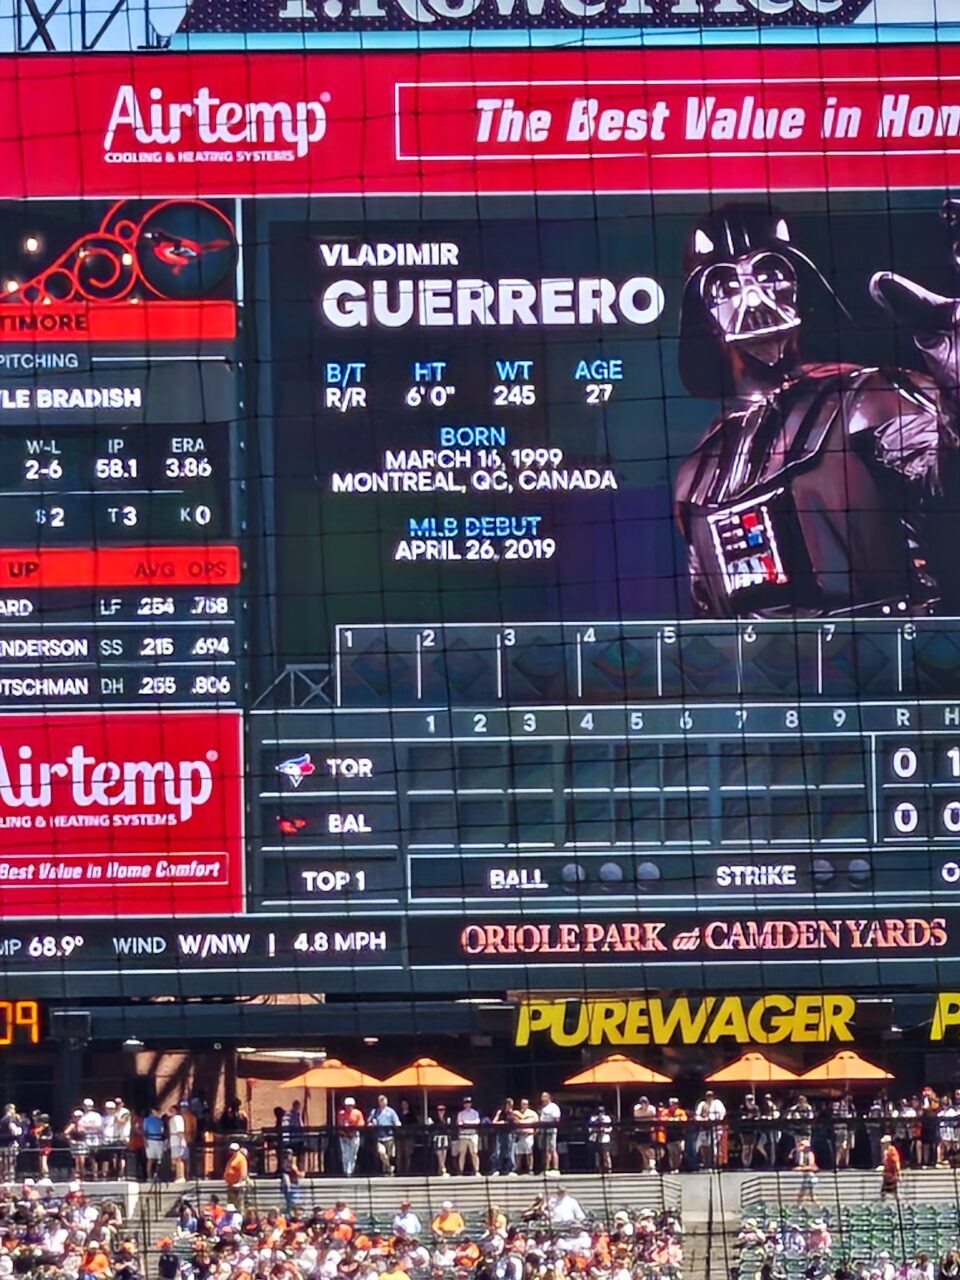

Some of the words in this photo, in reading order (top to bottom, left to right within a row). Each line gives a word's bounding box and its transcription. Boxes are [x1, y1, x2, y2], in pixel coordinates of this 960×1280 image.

[104, 85, 326, 157] Airtemp
[475, 98, 551, 141] The
[567, 97, 667, 141] Best
[685, 96, 804, 140] Value
[822, 97, 861, 137] in
[105, 152, 162, 163] COOLING
[178, 151, 233, 162] HEATING
[236, 150, 295, 161] SYSTEMS
[320, 243, 459, 266] VLADIMIR
[322, 276, 665, 328] GUERRERO
[327, 363, 366, 387] B/T
[415, 362, 446, 381] HT
[496, 361, 533, 380] WT
[575, 360, 623, 380] AGE
[37, 388, 142, 408] BRADISH
[326, 387, 366, 411] R/R
[493, 385, 535, 406] 245
[586, 384, 613, 404] 27
[109, 440, 124, 453] IP
[172, 438, 205, 452] ERA
[441, 427, 506, 446] BORN
[25, 460, 62, 479] 2-6
[96, 459, 138, 478] 58.1
[165, 458, 212, 477] 3.86
[386, 450, 471, 470] MARCH
[511, 449, 563, 468] 1999
[332, 472, 466, 494] MONTREAL,
[519, 470, 618, 491] CANADA
[410, 518, 458, 537] MLB
[466, 517, 542, 537] DEBUT
[395, 540, 461, 560] APRIL
[505, 539, 555, 559] 2019
[135, 562, 175, 577] AVG
[188, 562, 227, 577] OPS
[100, 640, 123, 655] SS
[101, 678, 124, 694] DH
[327, 758, 373, 778] TOR
[893, 746, 917, 778] 0
[328, 814, 372, 834] BAL
[156, 860, 220, 878] Comfort
[490, 869, 548, 889] BALL
[716, 864, 797, 887] STRIKE
[302, 871, 350, 891] TOP
[113, 937, 166, 955] WIND
[178, 933, 250, 958] W/NW
[294, 933, 328, 951] 4.8
[334, 931, 387, 951] MPH
[462, 923, 580, 954] ORIOLE
[584, 922, 667, 952] PARK
[705, 920, 842, 950] CAMDEN
[850, 918, 948, 948] YARDS
[515, 993, 857, 1048] PUREWAGER
